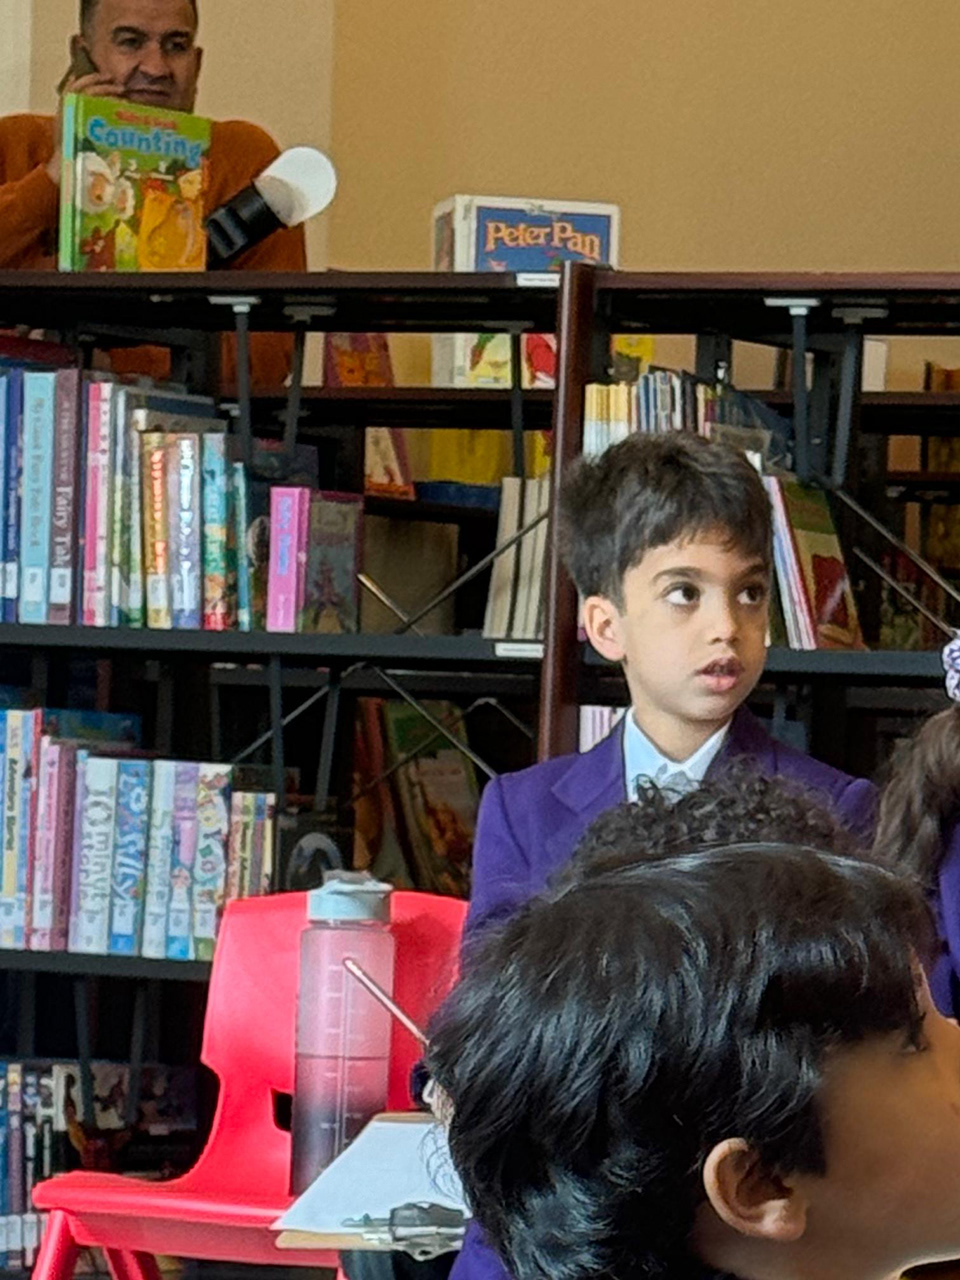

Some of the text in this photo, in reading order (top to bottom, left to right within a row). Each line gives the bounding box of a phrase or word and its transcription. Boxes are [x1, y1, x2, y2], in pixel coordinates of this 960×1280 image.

[88, 116, 202, 168] Counting
[485, 221, 601, 261] Peter Pan
[53, 486, 73, 529] Fairy
[84, 785, 114, 901] 10 minut
